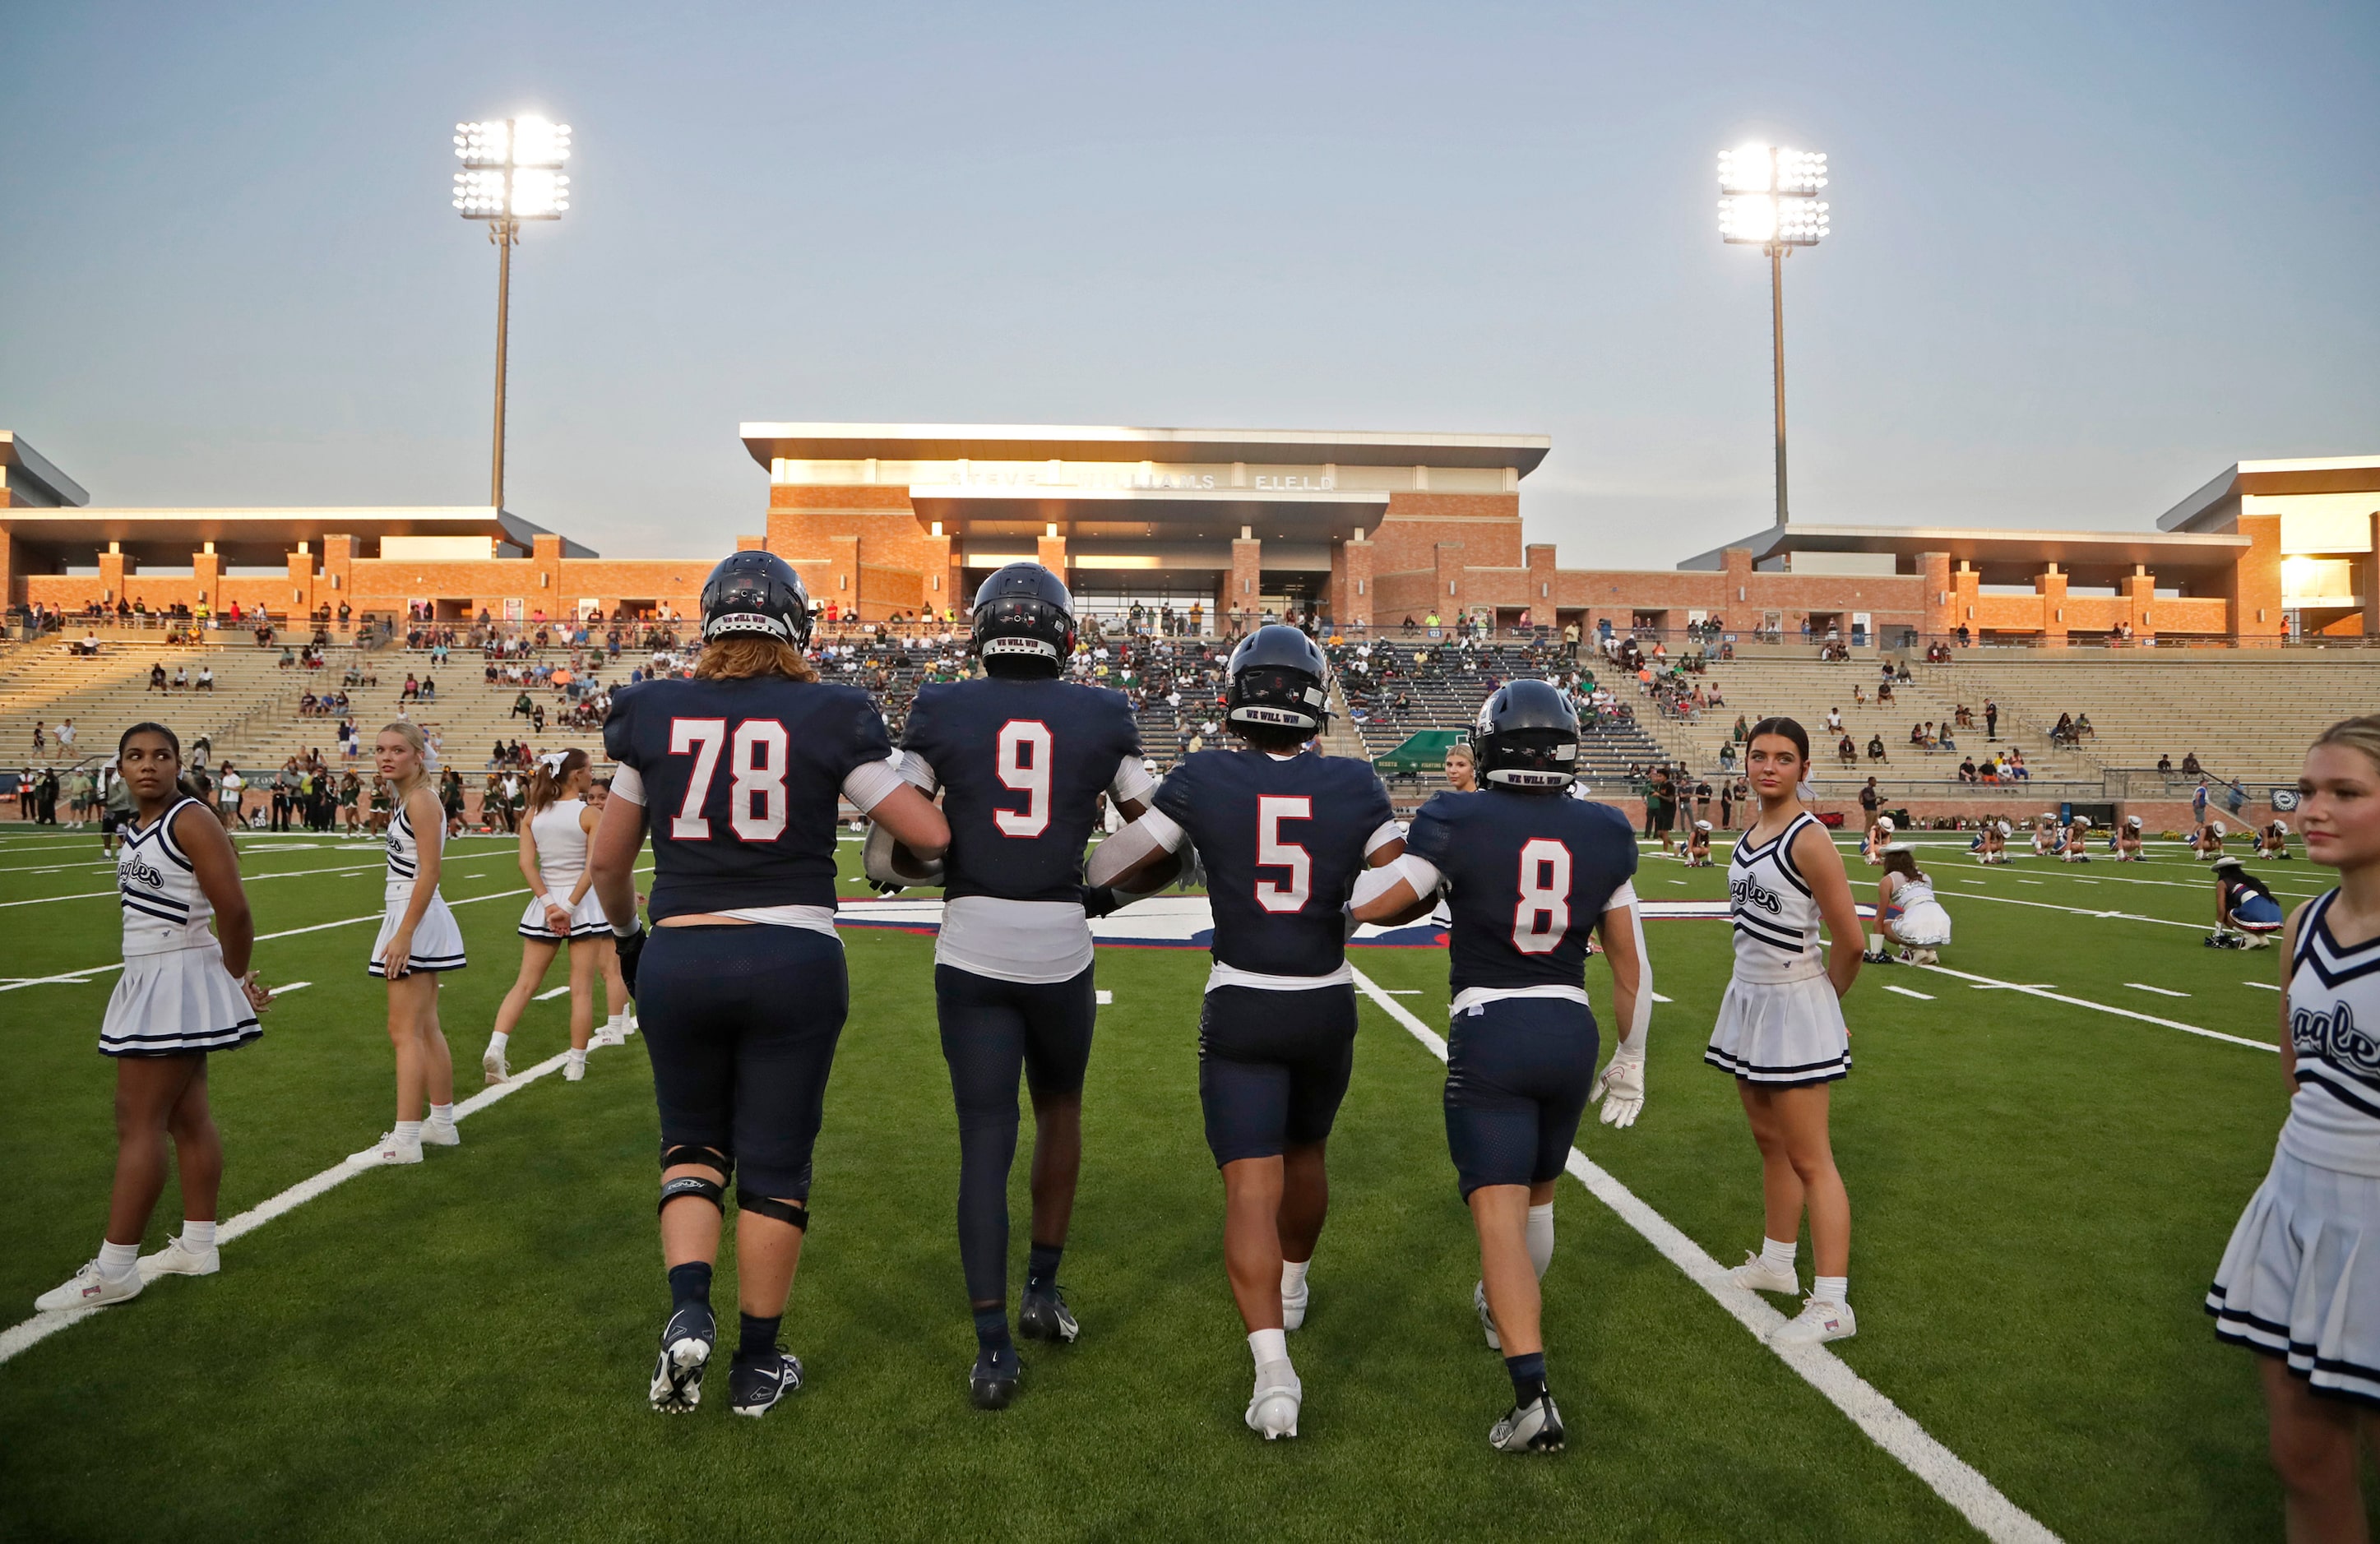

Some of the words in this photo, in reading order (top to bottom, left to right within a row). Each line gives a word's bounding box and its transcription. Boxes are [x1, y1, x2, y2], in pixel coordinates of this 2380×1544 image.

[949, 473, 1036, 486] STEVE
[1077, 473, 1215, 489] WILLIAMS
[1255, 475, 1334, 491] FIELD
[737, 579, 753, 589] 78
[752, 615, 766, 624] WIN
[1026, 640, 1039, 648] WIN
[1246, 710, 1258, 719] WE
[1260, 710, 1280, 723] WILL
[1283, 714, 1299, 723] WIN
[253, 776, 276, 784] ZON
[668, 717, 789, 842] 78
[993, 719, 1054, 839] 9
[1507, 774, 1521, 784] WE
[1523, 774, 1544, 784] WILL
[1547, 776, 1562, 784] WIN
[254, 818, 266, 827] 20
[850, 822, 862, 831] 40
[1254, 794, 1313, 913] 5
[1510, 837, 1573, 955] 8
